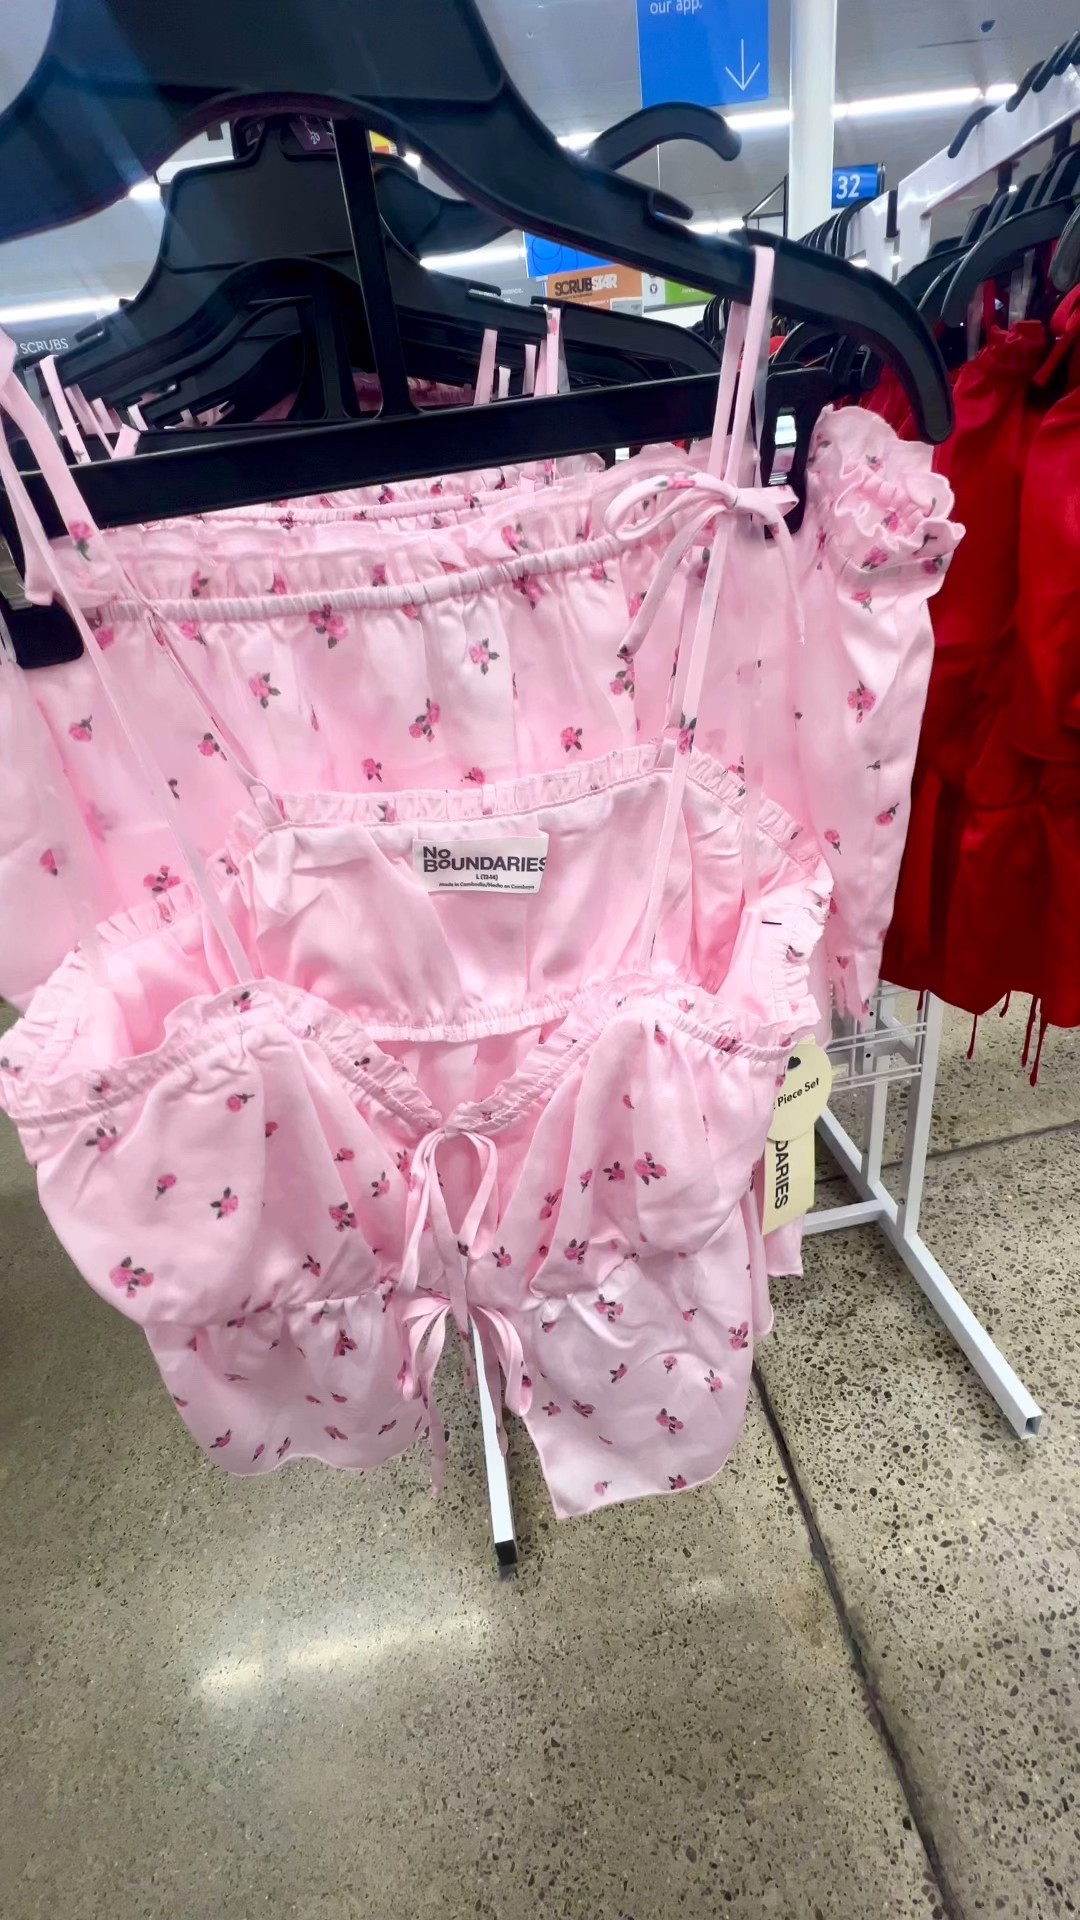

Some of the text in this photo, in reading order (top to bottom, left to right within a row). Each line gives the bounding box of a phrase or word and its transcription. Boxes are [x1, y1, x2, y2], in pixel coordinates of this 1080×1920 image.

[650, 0, 702, 16] our app.
[836, 173, 860, 200] 32
[554, 273, 618, 297] SCRUBSTAR
[19, 338, 69, 354] SCRUBS
[777, 1088, 803, 1107] Piece
[804, 1077, 819, 1092] Set
[774, 1140, 789, 1209] DARIES
